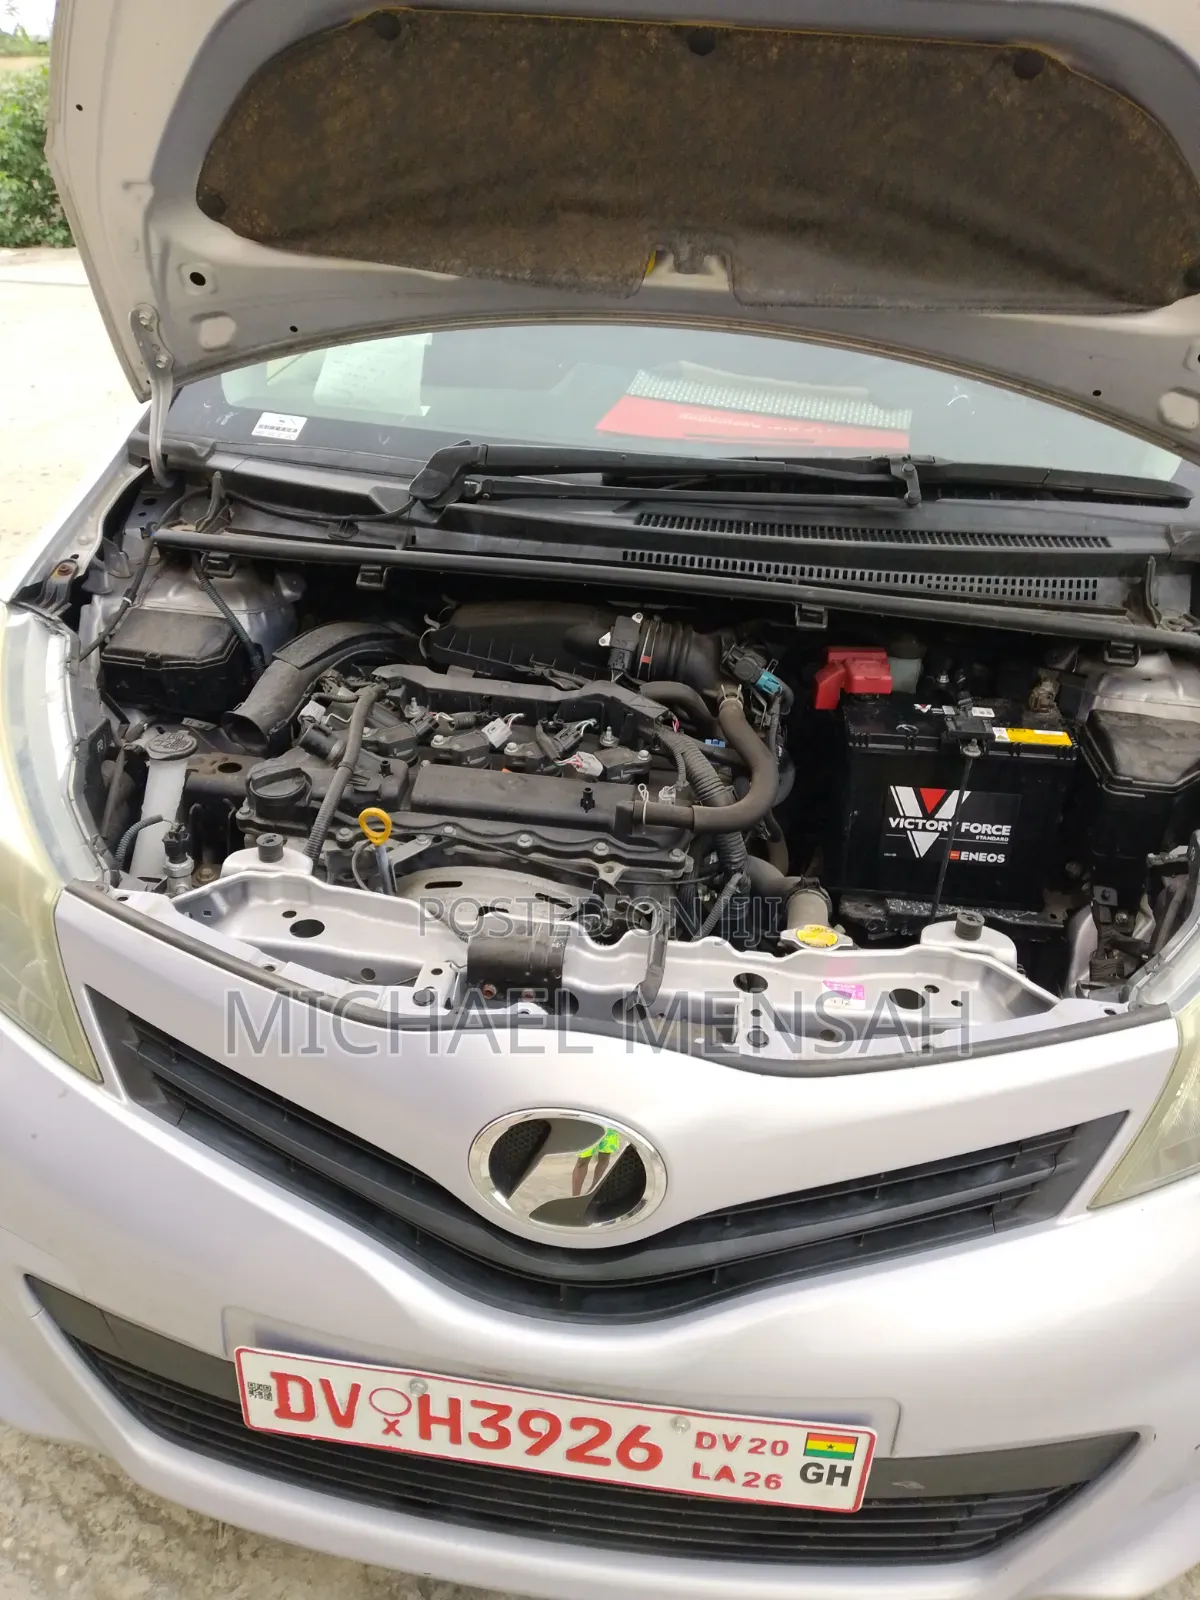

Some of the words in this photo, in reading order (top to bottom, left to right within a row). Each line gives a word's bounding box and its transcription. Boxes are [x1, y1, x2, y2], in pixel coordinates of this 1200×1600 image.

[960, 822, 1012, 836] FORCE
[960, 851, 1006, 864] ENEOS
[270, 1371, 362, 1429] DV
[416, 1393, 663, 1472] H3926
[800, 1462, 852, 1487] GH
